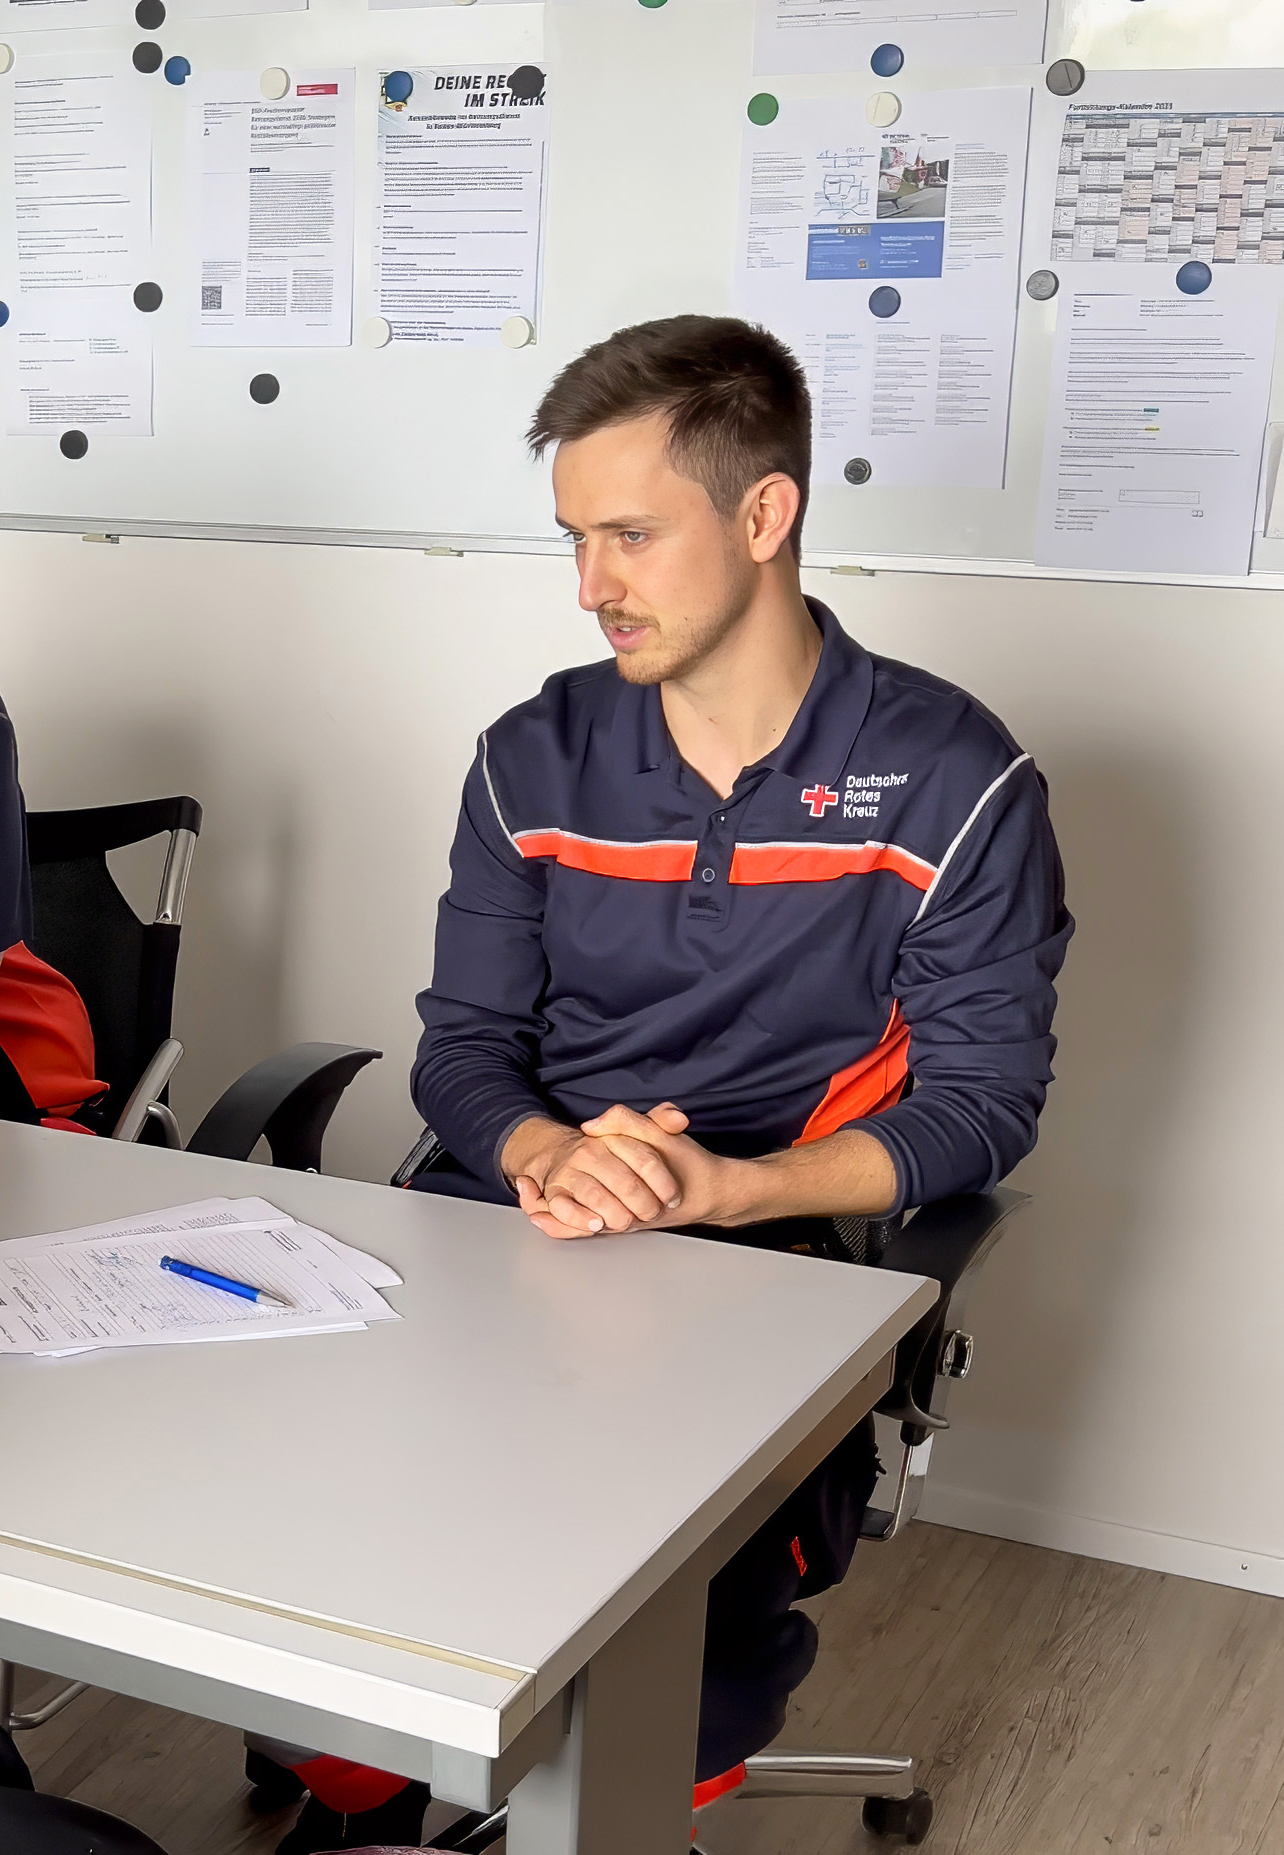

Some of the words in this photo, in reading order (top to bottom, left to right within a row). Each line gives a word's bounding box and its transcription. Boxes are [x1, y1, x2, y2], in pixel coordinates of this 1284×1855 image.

[434, 75, 482, 90] DEINE
[464, 93, 485, 107] IM
[844, 789, 881, 803] Rotes
[843, 803, 879, 818] Kreuz
